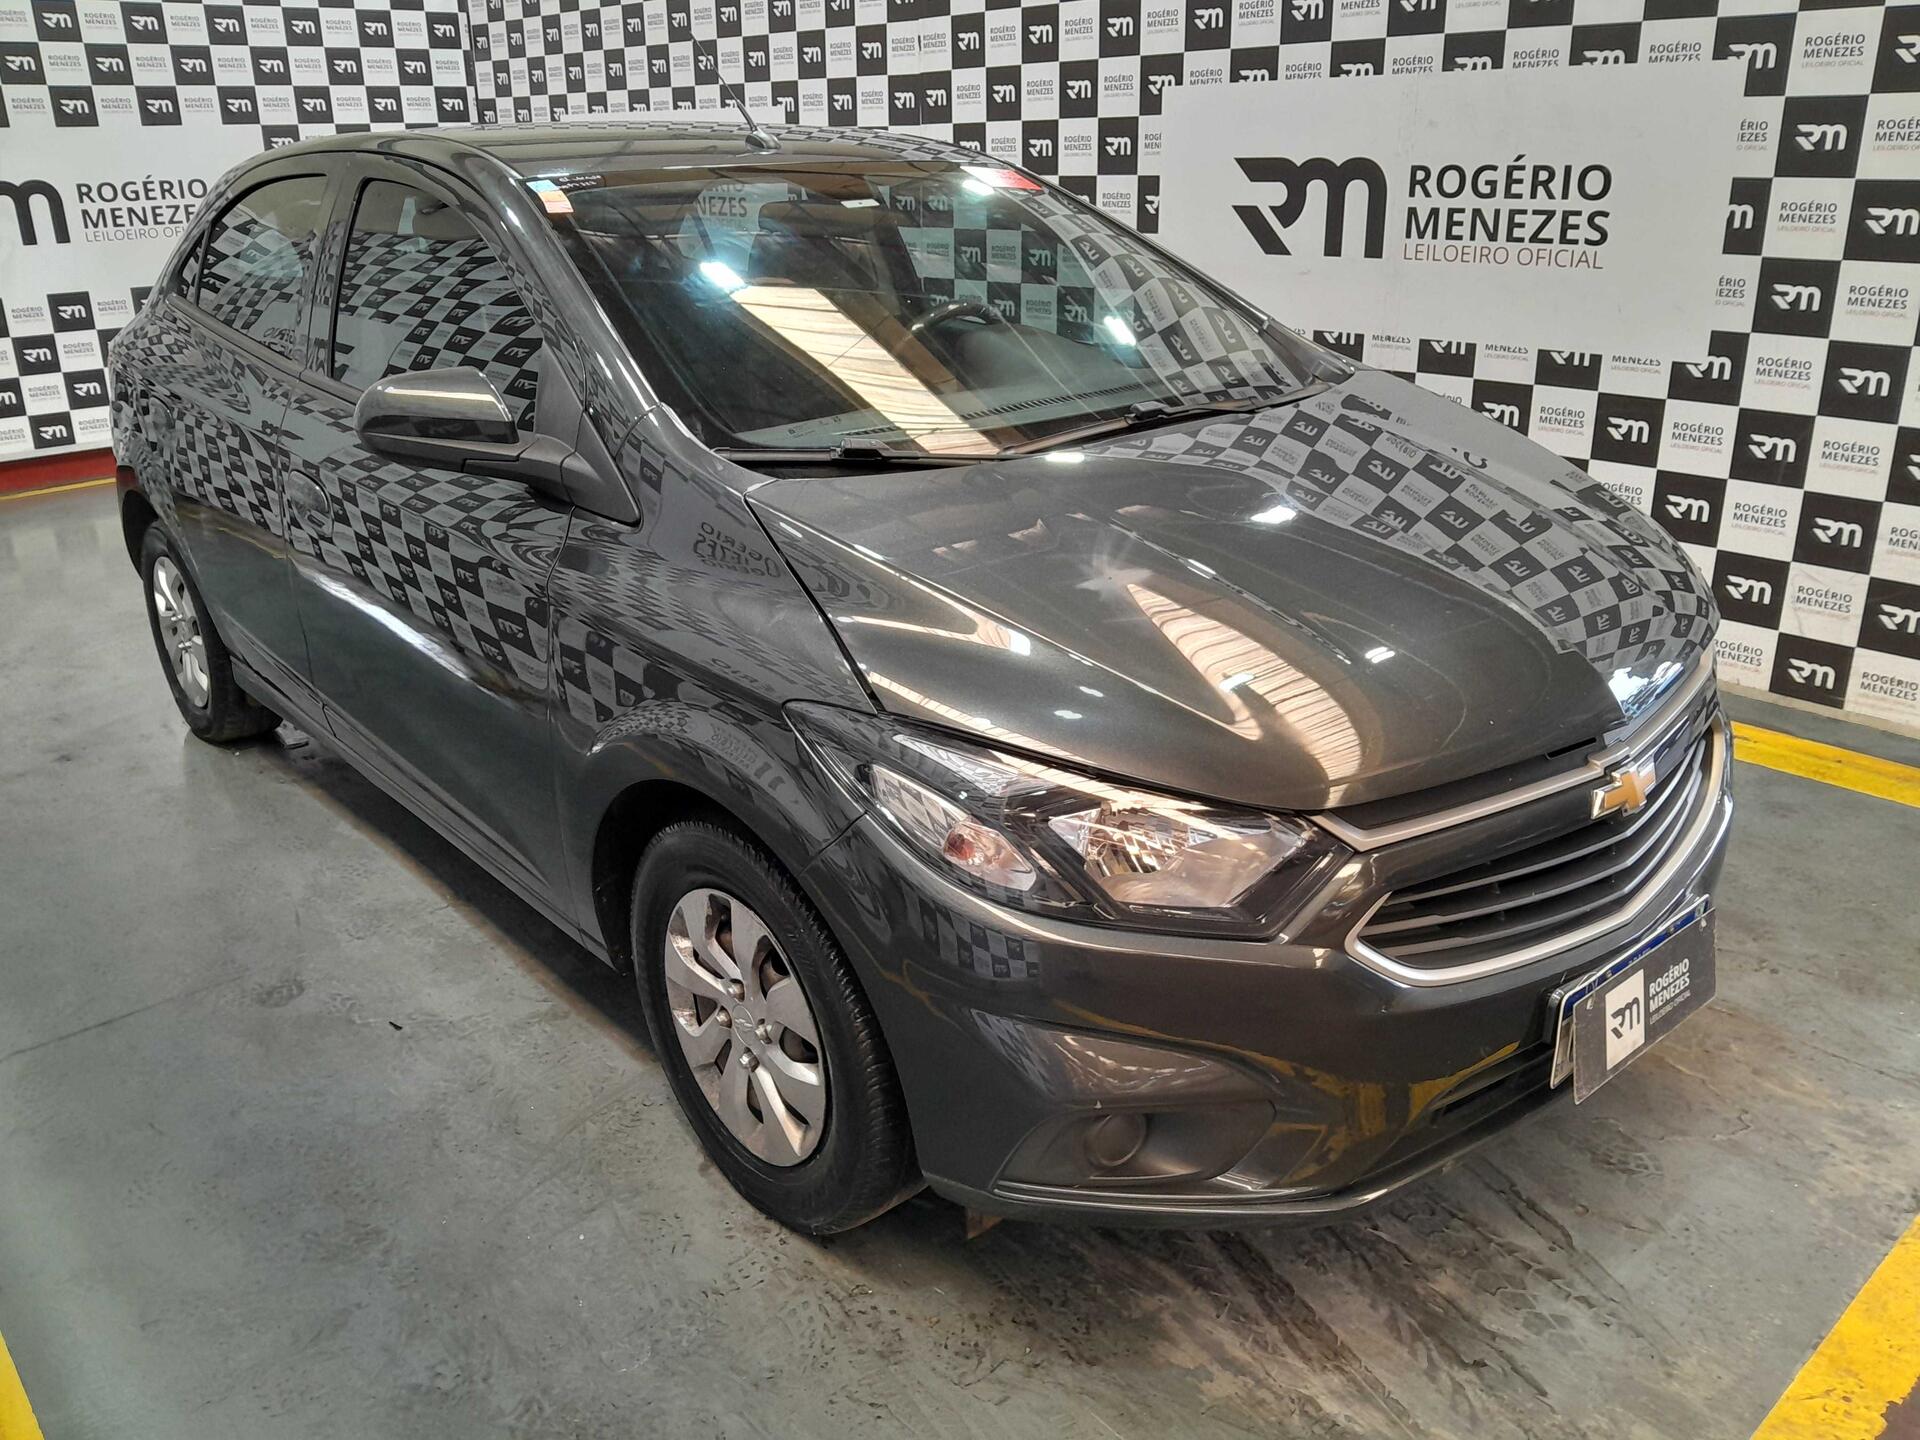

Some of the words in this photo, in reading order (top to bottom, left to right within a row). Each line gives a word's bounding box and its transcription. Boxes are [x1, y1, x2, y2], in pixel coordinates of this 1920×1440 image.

[1341, 0, 1381, 10] MENEZES
[1147, 9, 1179, 19] ROGÉRIO
[1239, 9, 1274, 19] MENEZES
[1065, 18, 1094, 27] ROGÉRIO
[1147, 18, 1179, 28] MENEZES
[990, 25, 1016, 34] ROGÉRIO
[1065, 26, 1093, 35] MENEZES
[990, 34, 1016, 42] MENEZES
[1804, 32, 1866, 47] ROGÉRIO
[1650, 40, 1702, 54] ROGÉRIO
[1803, 46, 1864, 59] MENEZES
[1513, 48, 1559, 61] ROGÉRIO
[1393, 56, 1434, 67] ROGÉRIO
[1190, 69, 1223, 78] ROGÉRIO
[1286, 63, 1322, 73] ROGÉRIO
[1026, 80, 1054, 88] ROGÉRIO
[1104, 74, 1134, 83] ROGÉRIO
[957, 84, 981, 92] ROGÉRIO
[1026, 87, 1054, 95] MENEZES
[1104, 82, 1134, 91] MENEZES
[1740, 119, 1768, 131] ÉRIO
[1877, 119, 1920, 130] ROGÉR
[991, 135, 1016, 145] ROGÉRIO
[1064, 135, 1092, 143] ROGÉRIO
[1874, 131, 1920, 142] MENEZ
[991, 144, 1016, 152] MENEZES
[1064, 143, 1092, 151] MENEZES
[1408, 154, 1613, 201] ROGÉRIO
[76, 174, 208, 204] ROGÉRIO
[1102, 192, 1131, 200] ROGÉRIO
[1102, 200, 1131, 208] MENEZES
[1780, 200, 1838, 213] ROGÉRIO
[81, 204, 197, 230] MENEZE
[1779, 213, 1836, 224] MENEZES
[1405, 206, 1611, 247] MENEZES
[85, 227, 159, 243] LEILOEIRO
[1402, 243, 1510, 266] LEILOEIRO
[1516, 247, 1605, 270] OFICIAL
[1719, 276, 1746, 288] ÉRIO
[1849, 285, 1909, 298] ROGÉRIO
[1847, 297, 1908, 309] MENEZES
[1757, 357, 1812, 370] ROGÉRIO
[1756, 367, 1811, 381] MENEZES
[1540, 406, 1585, 419] ROGÉRIO
[1539, 416, 1585, 429] MENEZES
[1673, 422, 1724, 436] ROGÉRIO
[1672, 432, 1723, 446] MENEZES
[1823, 440, 1880, 456] ROGÉRIO
[1821, 451, 1879, 467] MENEZES
[1734, 502, 1787, 518] ROGÉRIO
[1733, 512, 1786, 528] MENEZES
[1798, 586, 1852, 603] ROGÉRIO
[1796, 596, 1851, 614] MENEZES
[1862, 672, 1919, 691] ROGÉRIO
[1860, 682, 1917, 701] MENEZES
[1649, 958, 1690, 997] ROGÉRIO
[1649, 974, 1690, 1013] MENEZES
